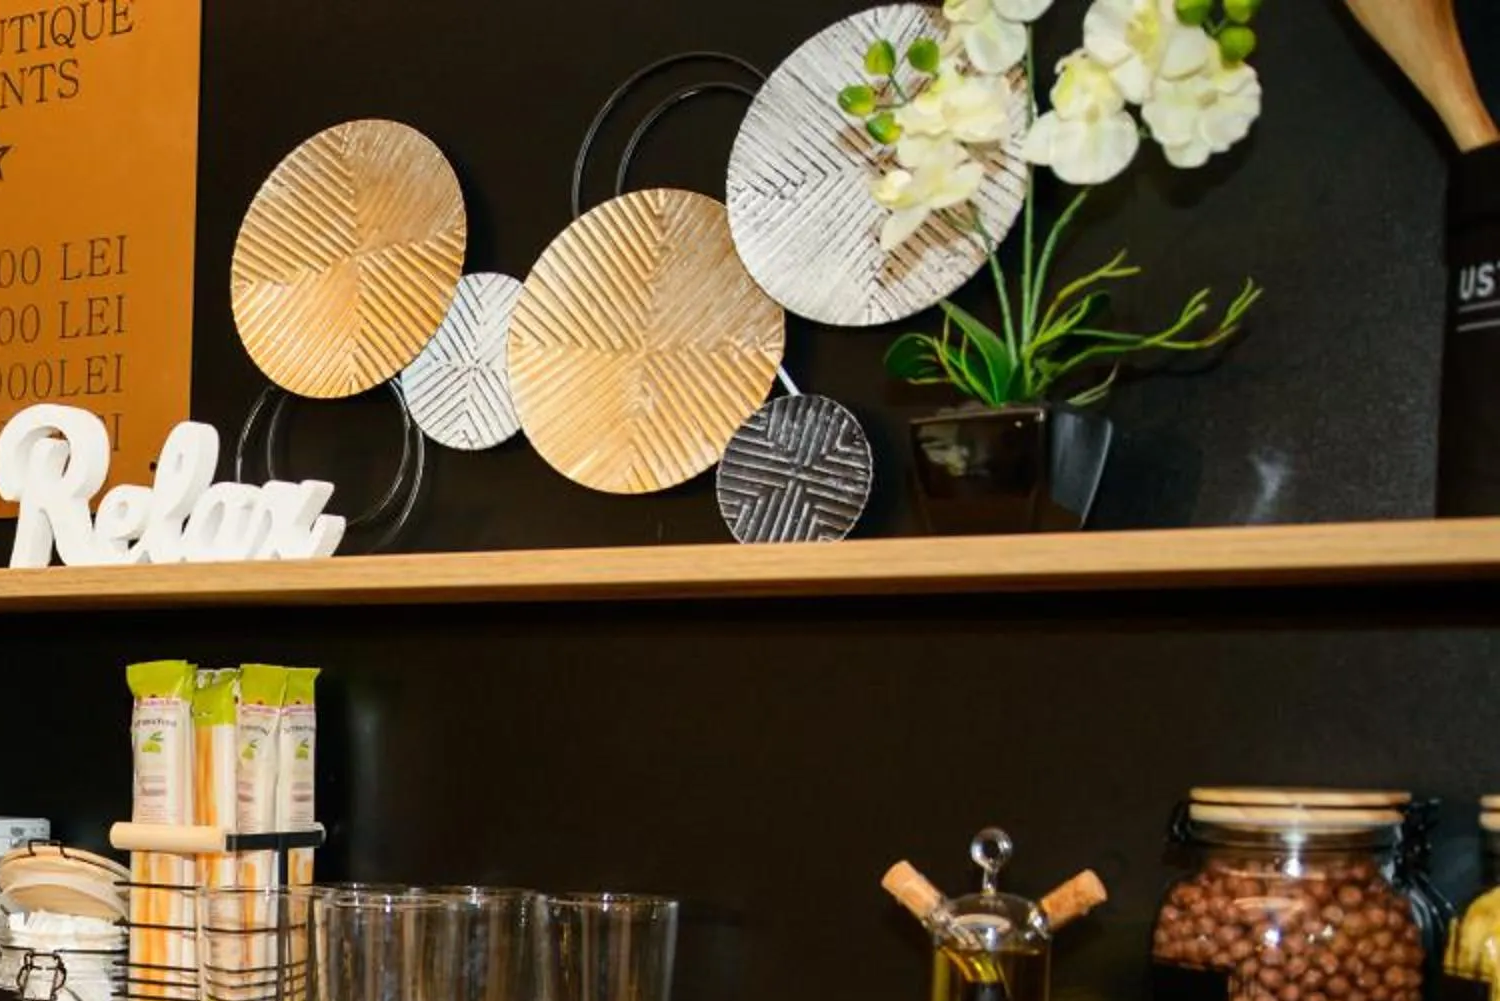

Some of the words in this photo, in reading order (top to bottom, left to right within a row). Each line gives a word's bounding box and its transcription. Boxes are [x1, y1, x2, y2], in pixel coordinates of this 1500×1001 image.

[59, 234, 130, 281] LEI
[1459, 261, 1500, 300] US
[57, 294, 127, 341] LEI
